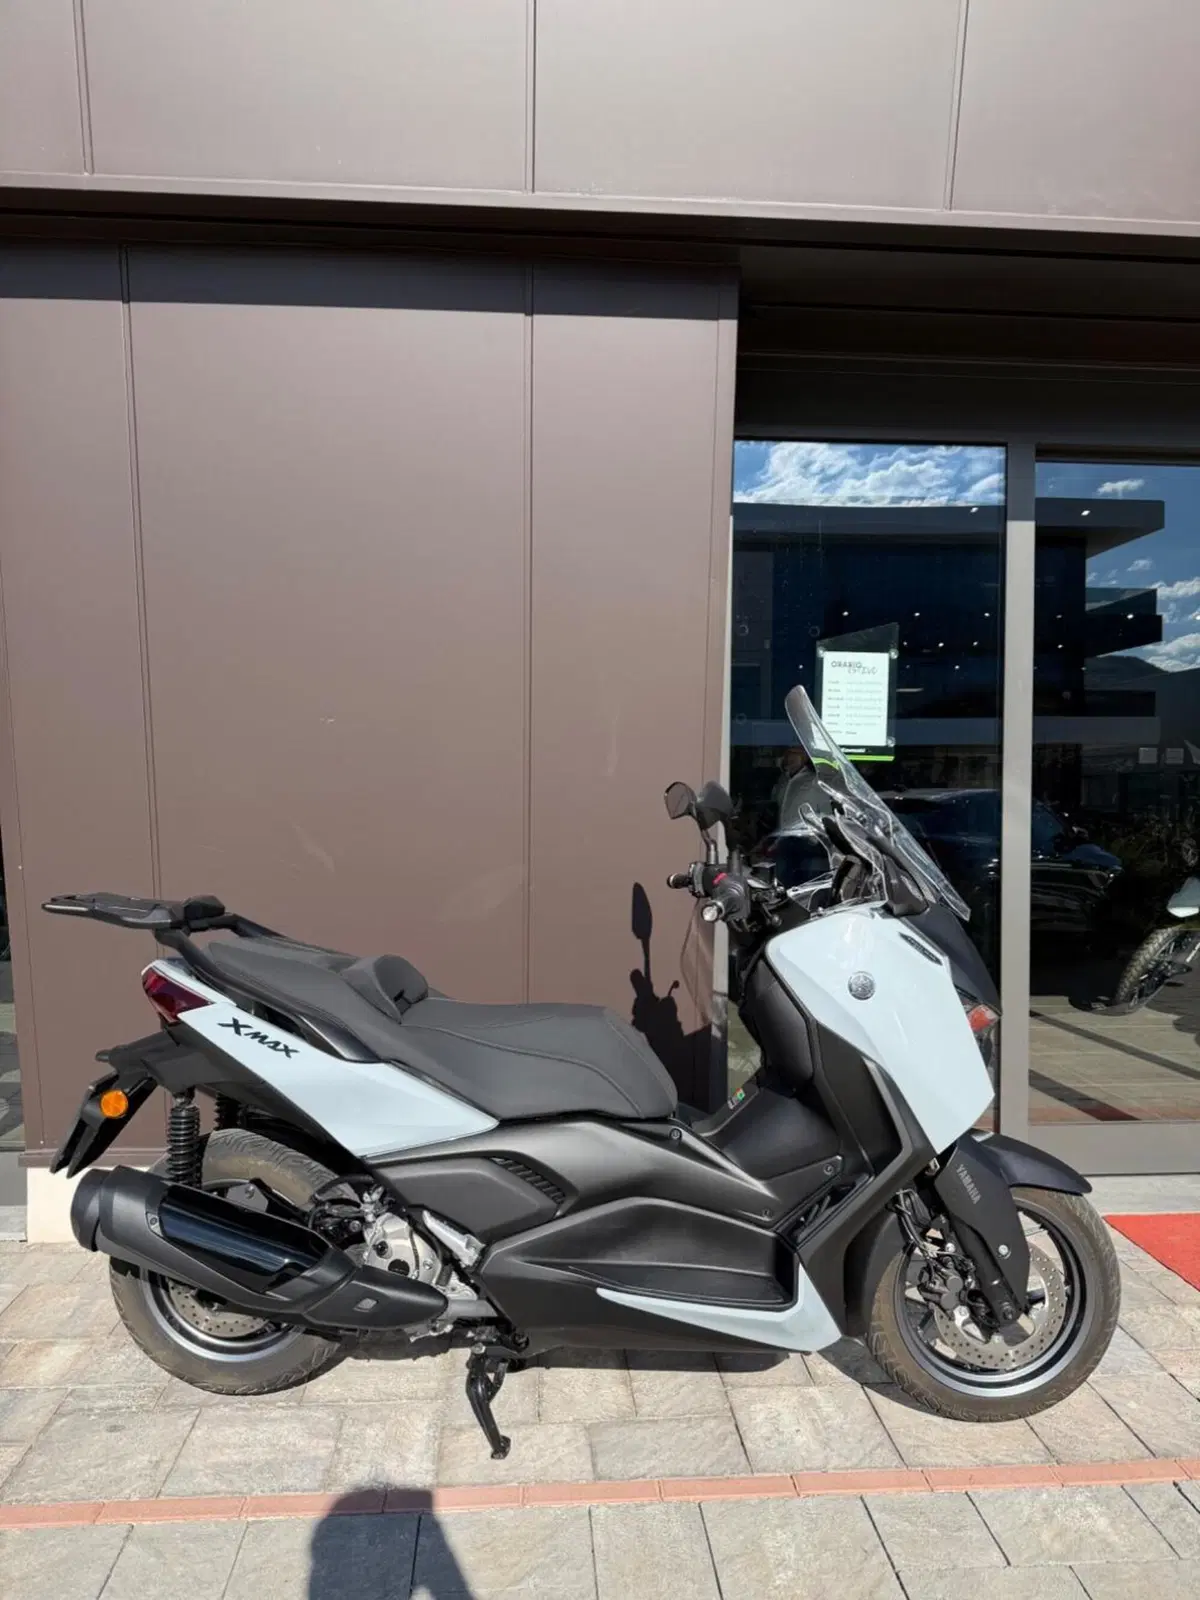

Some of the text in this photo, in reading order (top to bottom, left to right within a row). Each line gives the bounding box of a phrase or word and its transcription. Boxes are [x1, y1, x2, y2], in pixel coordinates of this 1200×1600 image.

[831, 660, 862, 668] ORARIO
[217, 1017, 300, 1059] XMAX
[956, 1164, 982, 1204] YAMAHA
